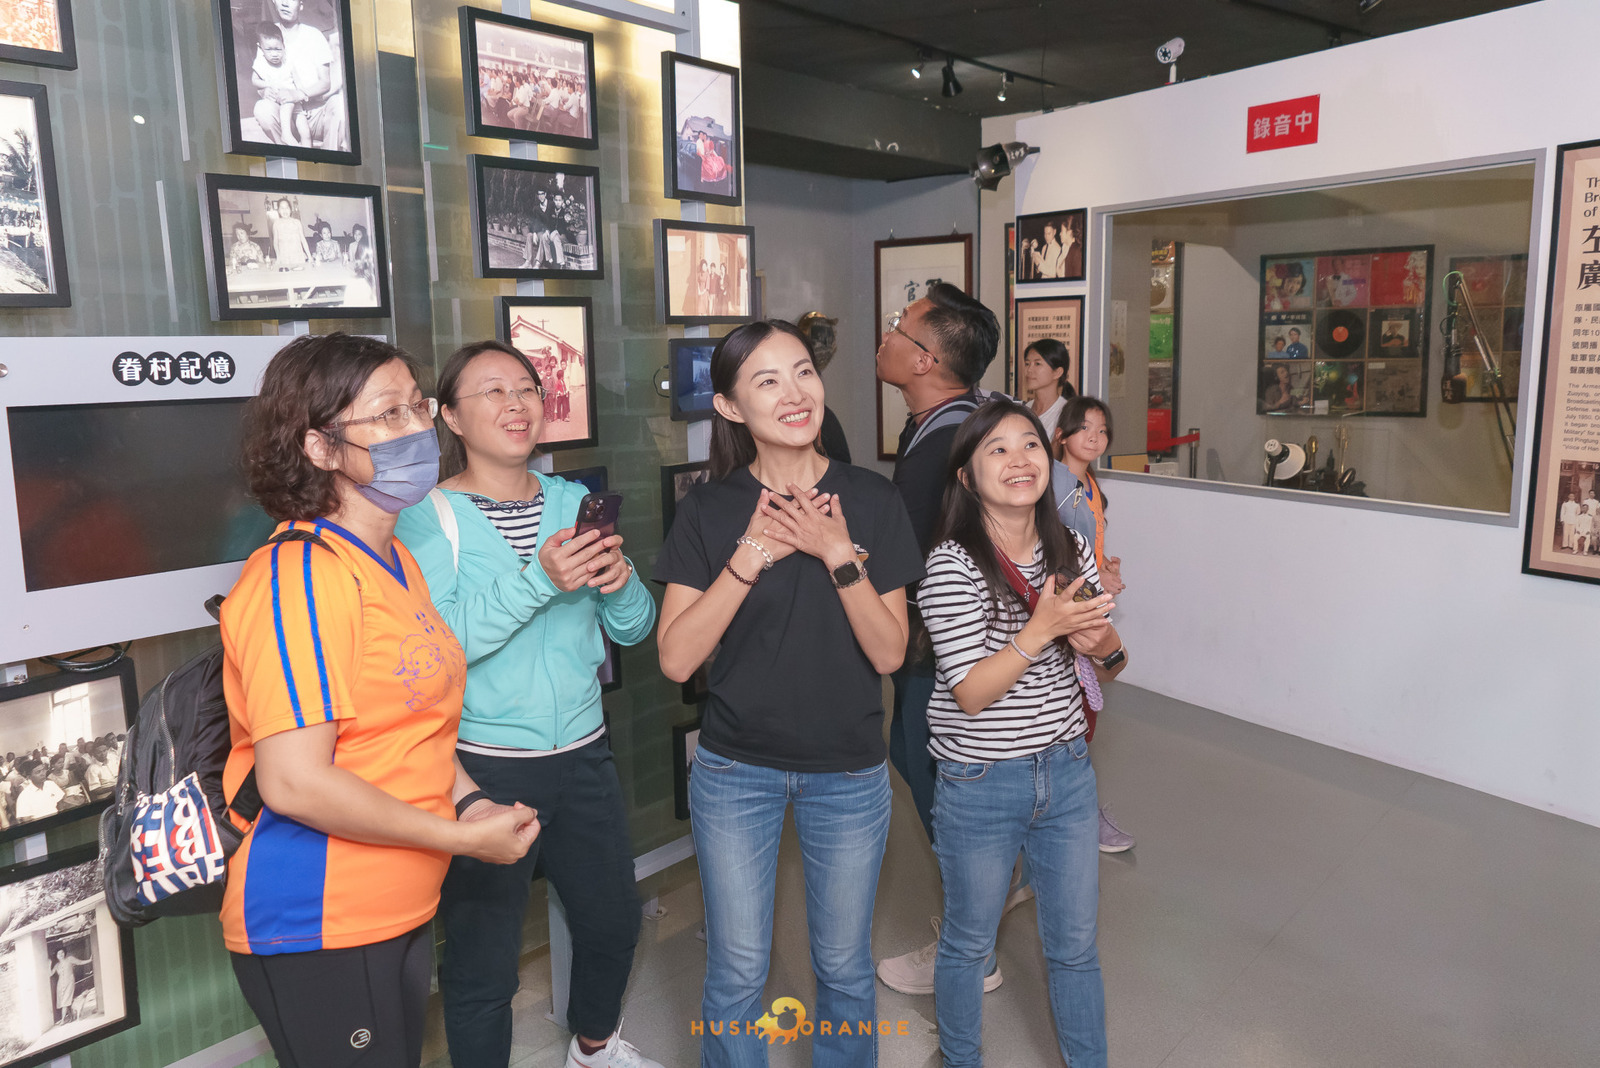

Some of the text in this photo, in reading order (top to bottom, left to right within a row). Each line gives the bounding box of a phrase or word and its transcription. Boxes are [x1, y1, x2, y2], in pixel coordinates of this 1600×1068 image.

[1253, 110, 1312, 140] 錄音中
[1584, 192, 1600, 203] Br
[1583, 206, 1598, 217] of
[118, 356, 231, 381] 眷村記憶
